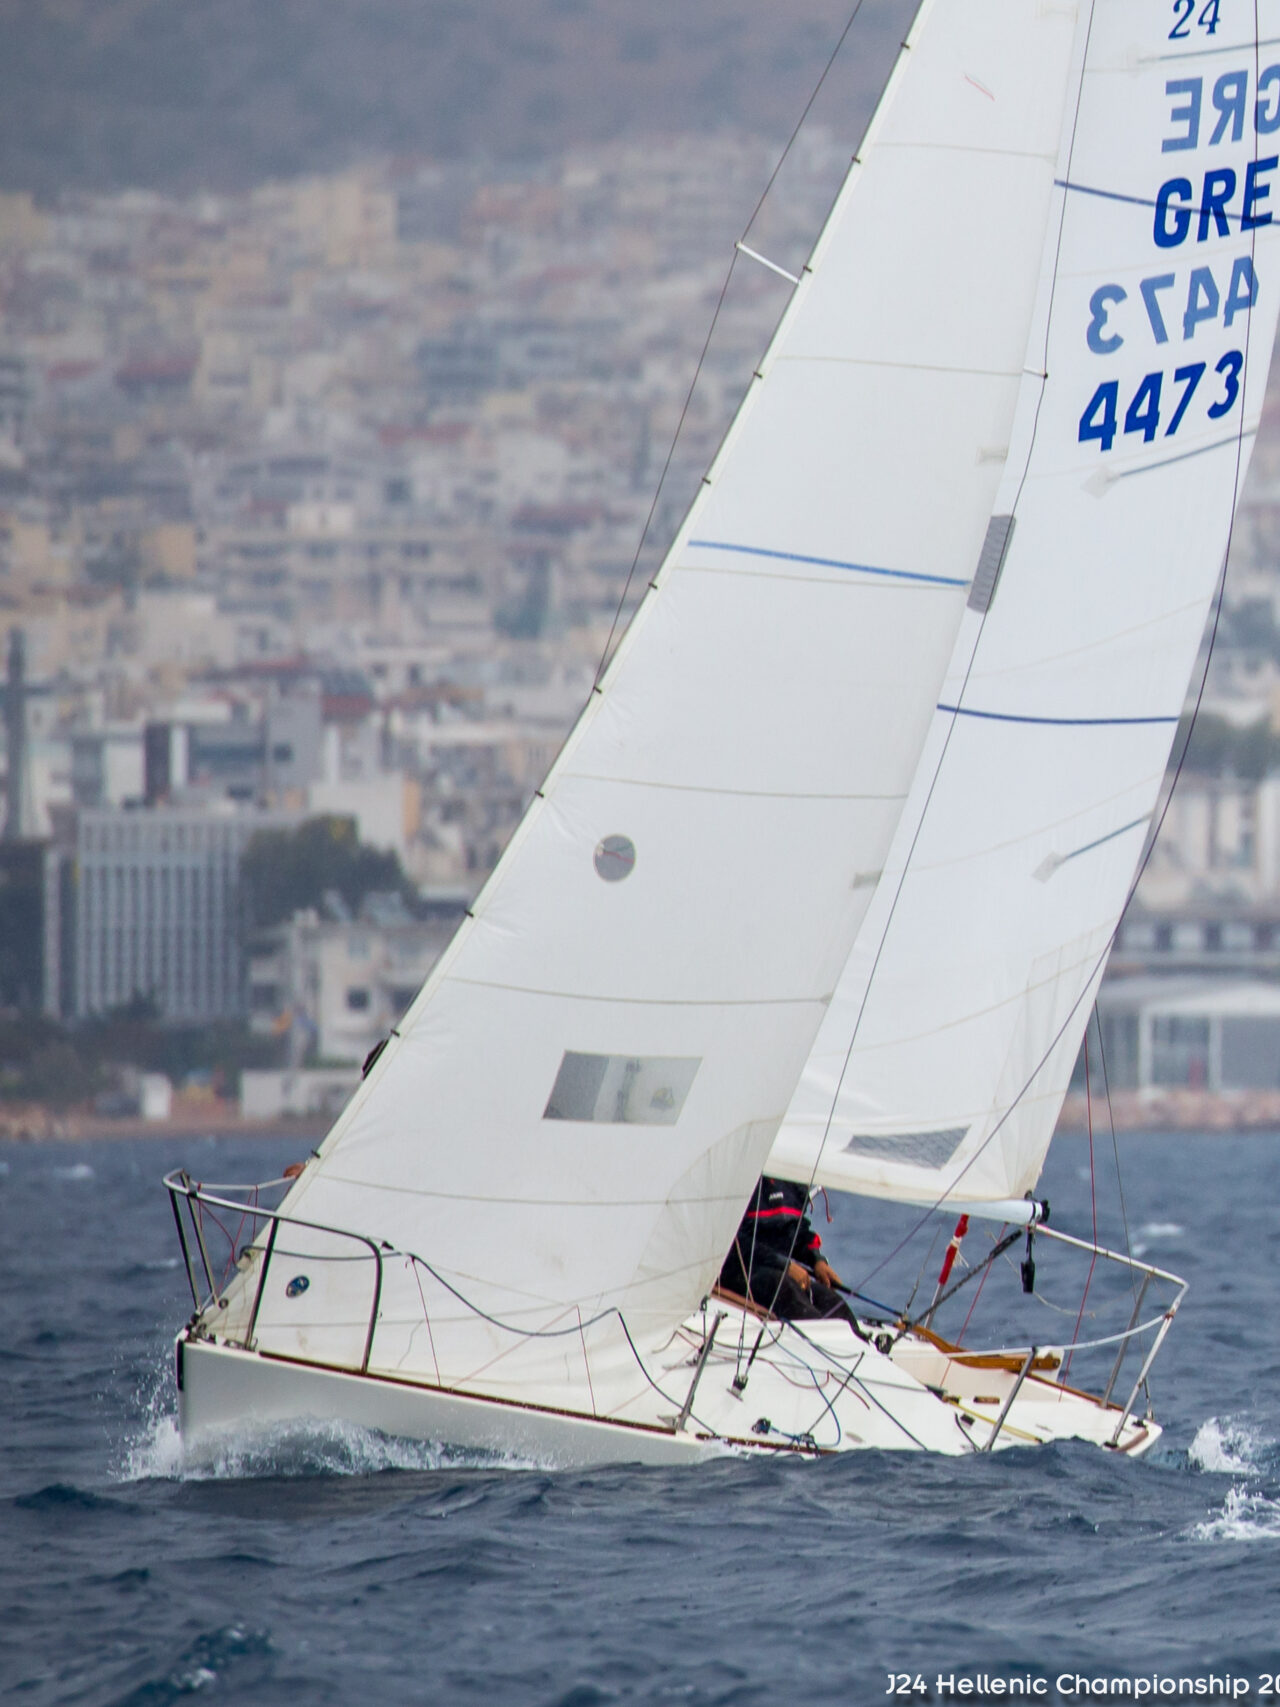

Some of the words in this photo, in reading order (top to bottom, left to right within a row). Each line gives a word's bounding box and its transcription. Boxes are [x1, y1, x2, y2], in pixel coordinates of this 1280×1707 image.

[1168, 0, 1221, 40] 24
[1153, 155, 1279, 248] GRE
[1077, 349, 1244, 452] 4473
